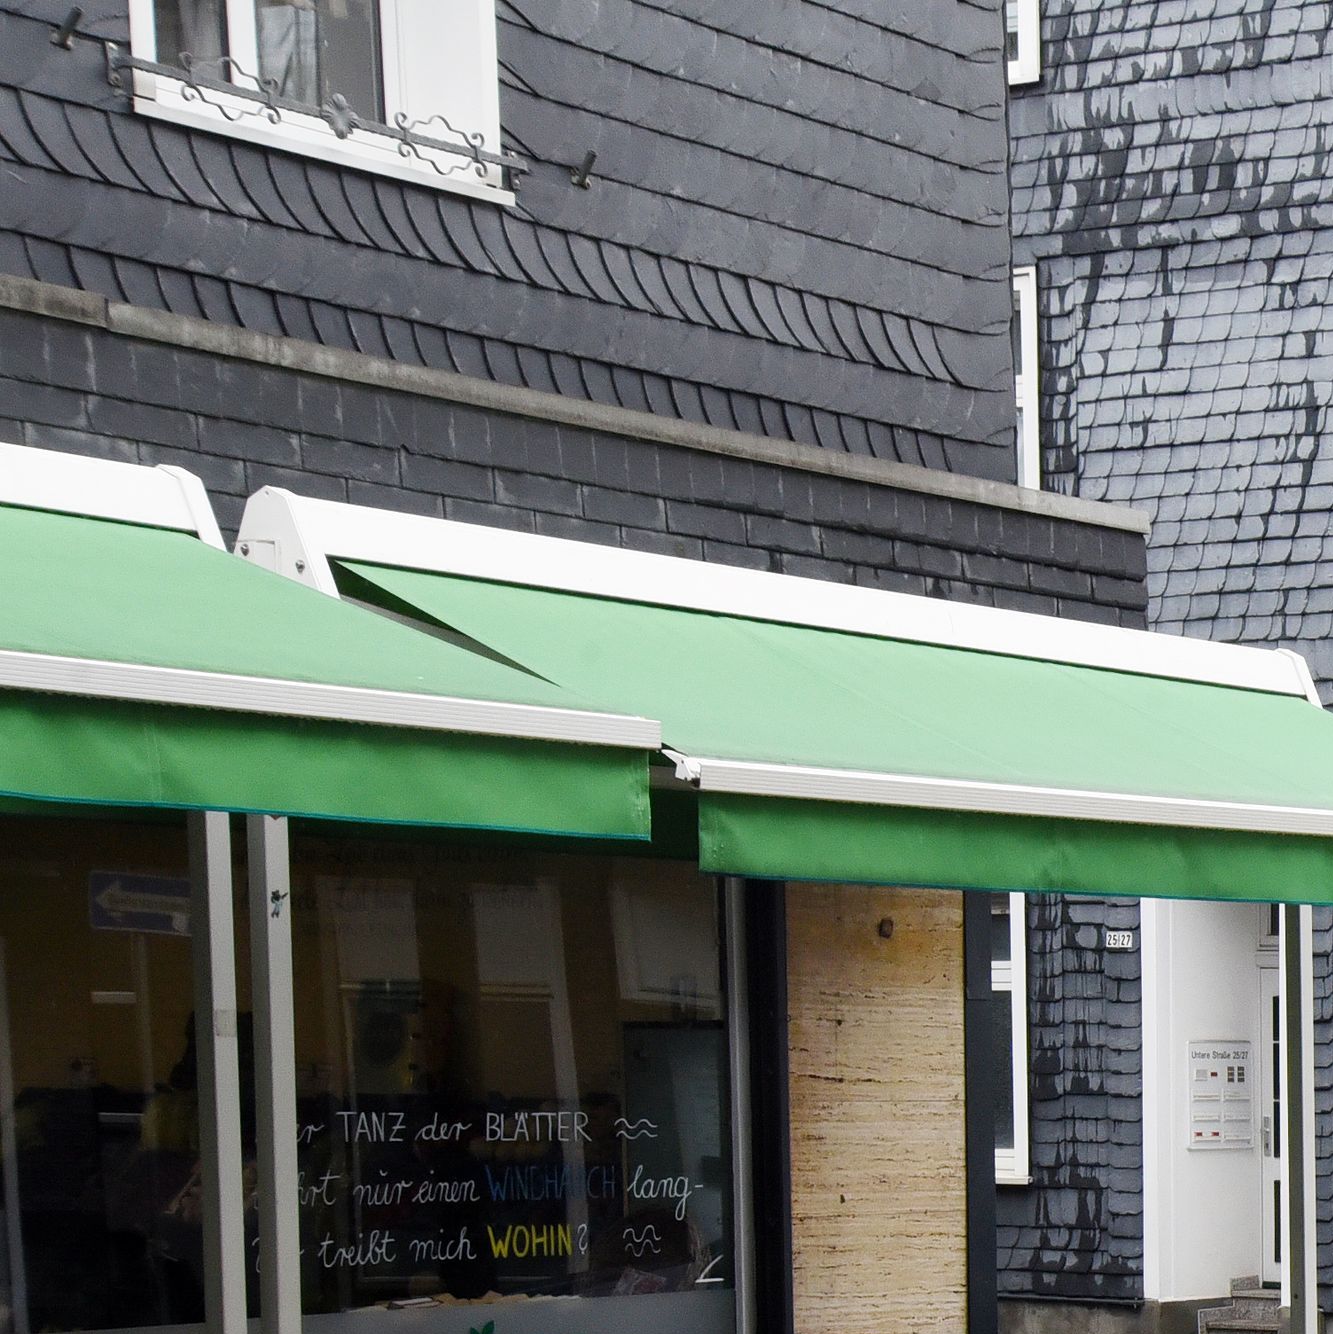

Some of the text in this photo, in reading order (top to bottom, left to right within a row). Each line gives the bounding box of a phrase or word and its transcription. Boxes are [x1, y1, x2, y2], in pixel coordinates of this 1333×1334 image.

[336, 1111, 407, 1143] TANZ
[414, 1111, 473, 1142] der
[486, 1111, 593, 1142] BLÄTTER
[412, 1169, 481, 1204] einen
[317, 1231, 398, 1269] treibt
[409, 1226, 478, 1263] mich
